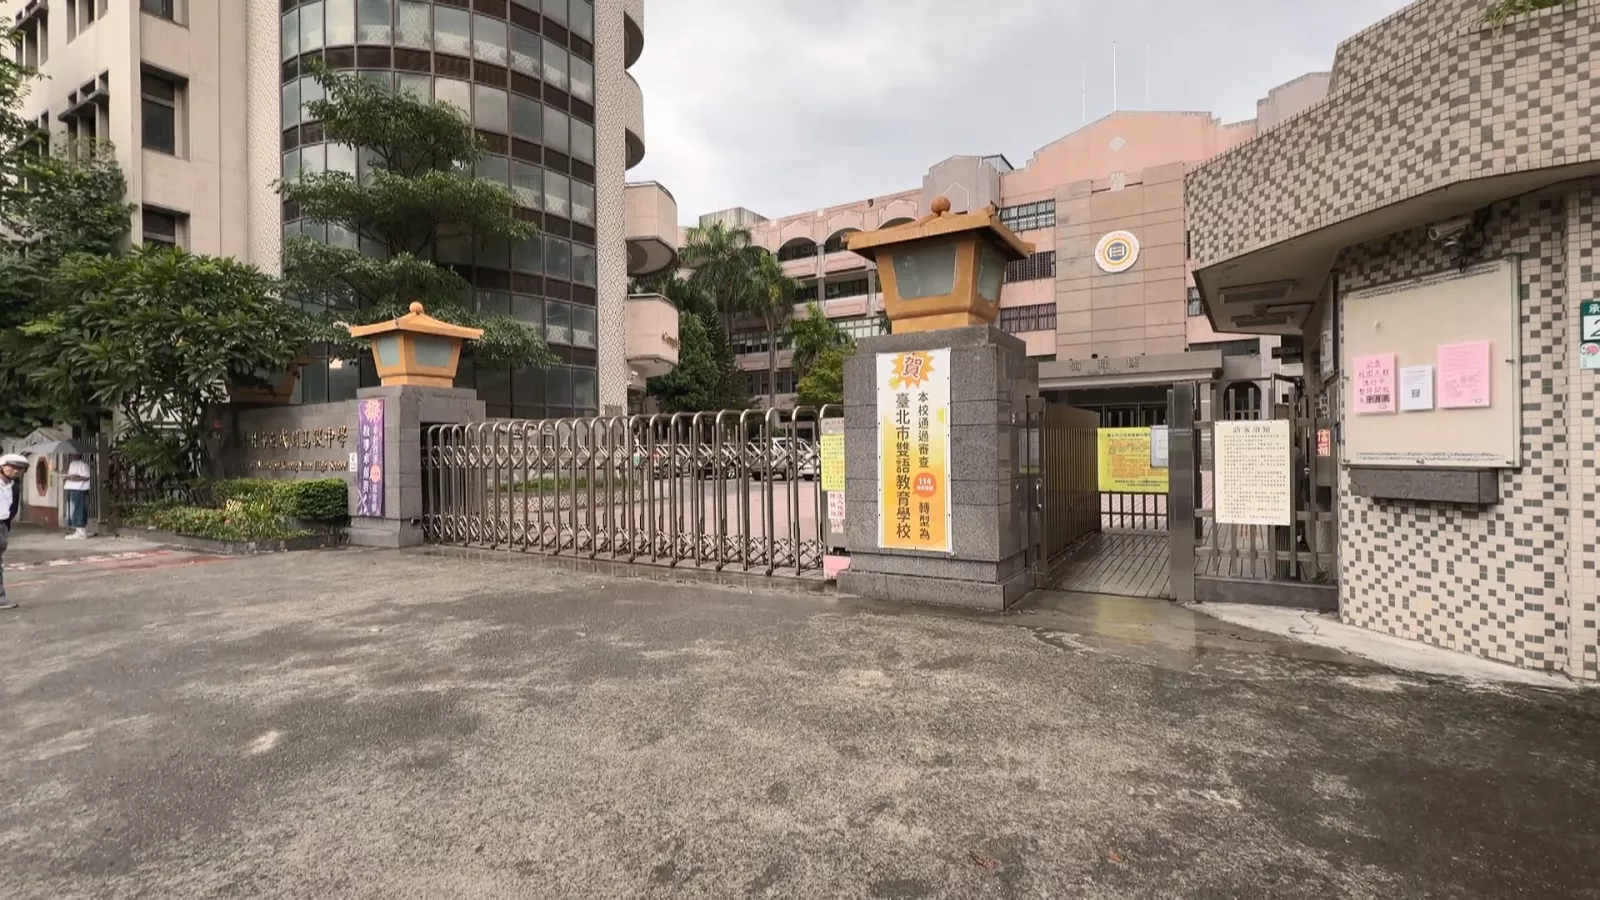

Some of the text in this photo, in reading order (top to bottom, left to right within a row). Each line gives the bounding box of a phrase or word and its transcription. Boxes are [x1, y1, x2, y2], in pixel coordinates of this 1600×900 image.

[902, 356, 923, 379] 賀
[918, 391, 930, 468] 本校通過審查
[895, 392, 911, 540] 臺北市雙語教育學校
[919, 477, 932, 486] 114
[918, 502, 930, 541] 轉型為
